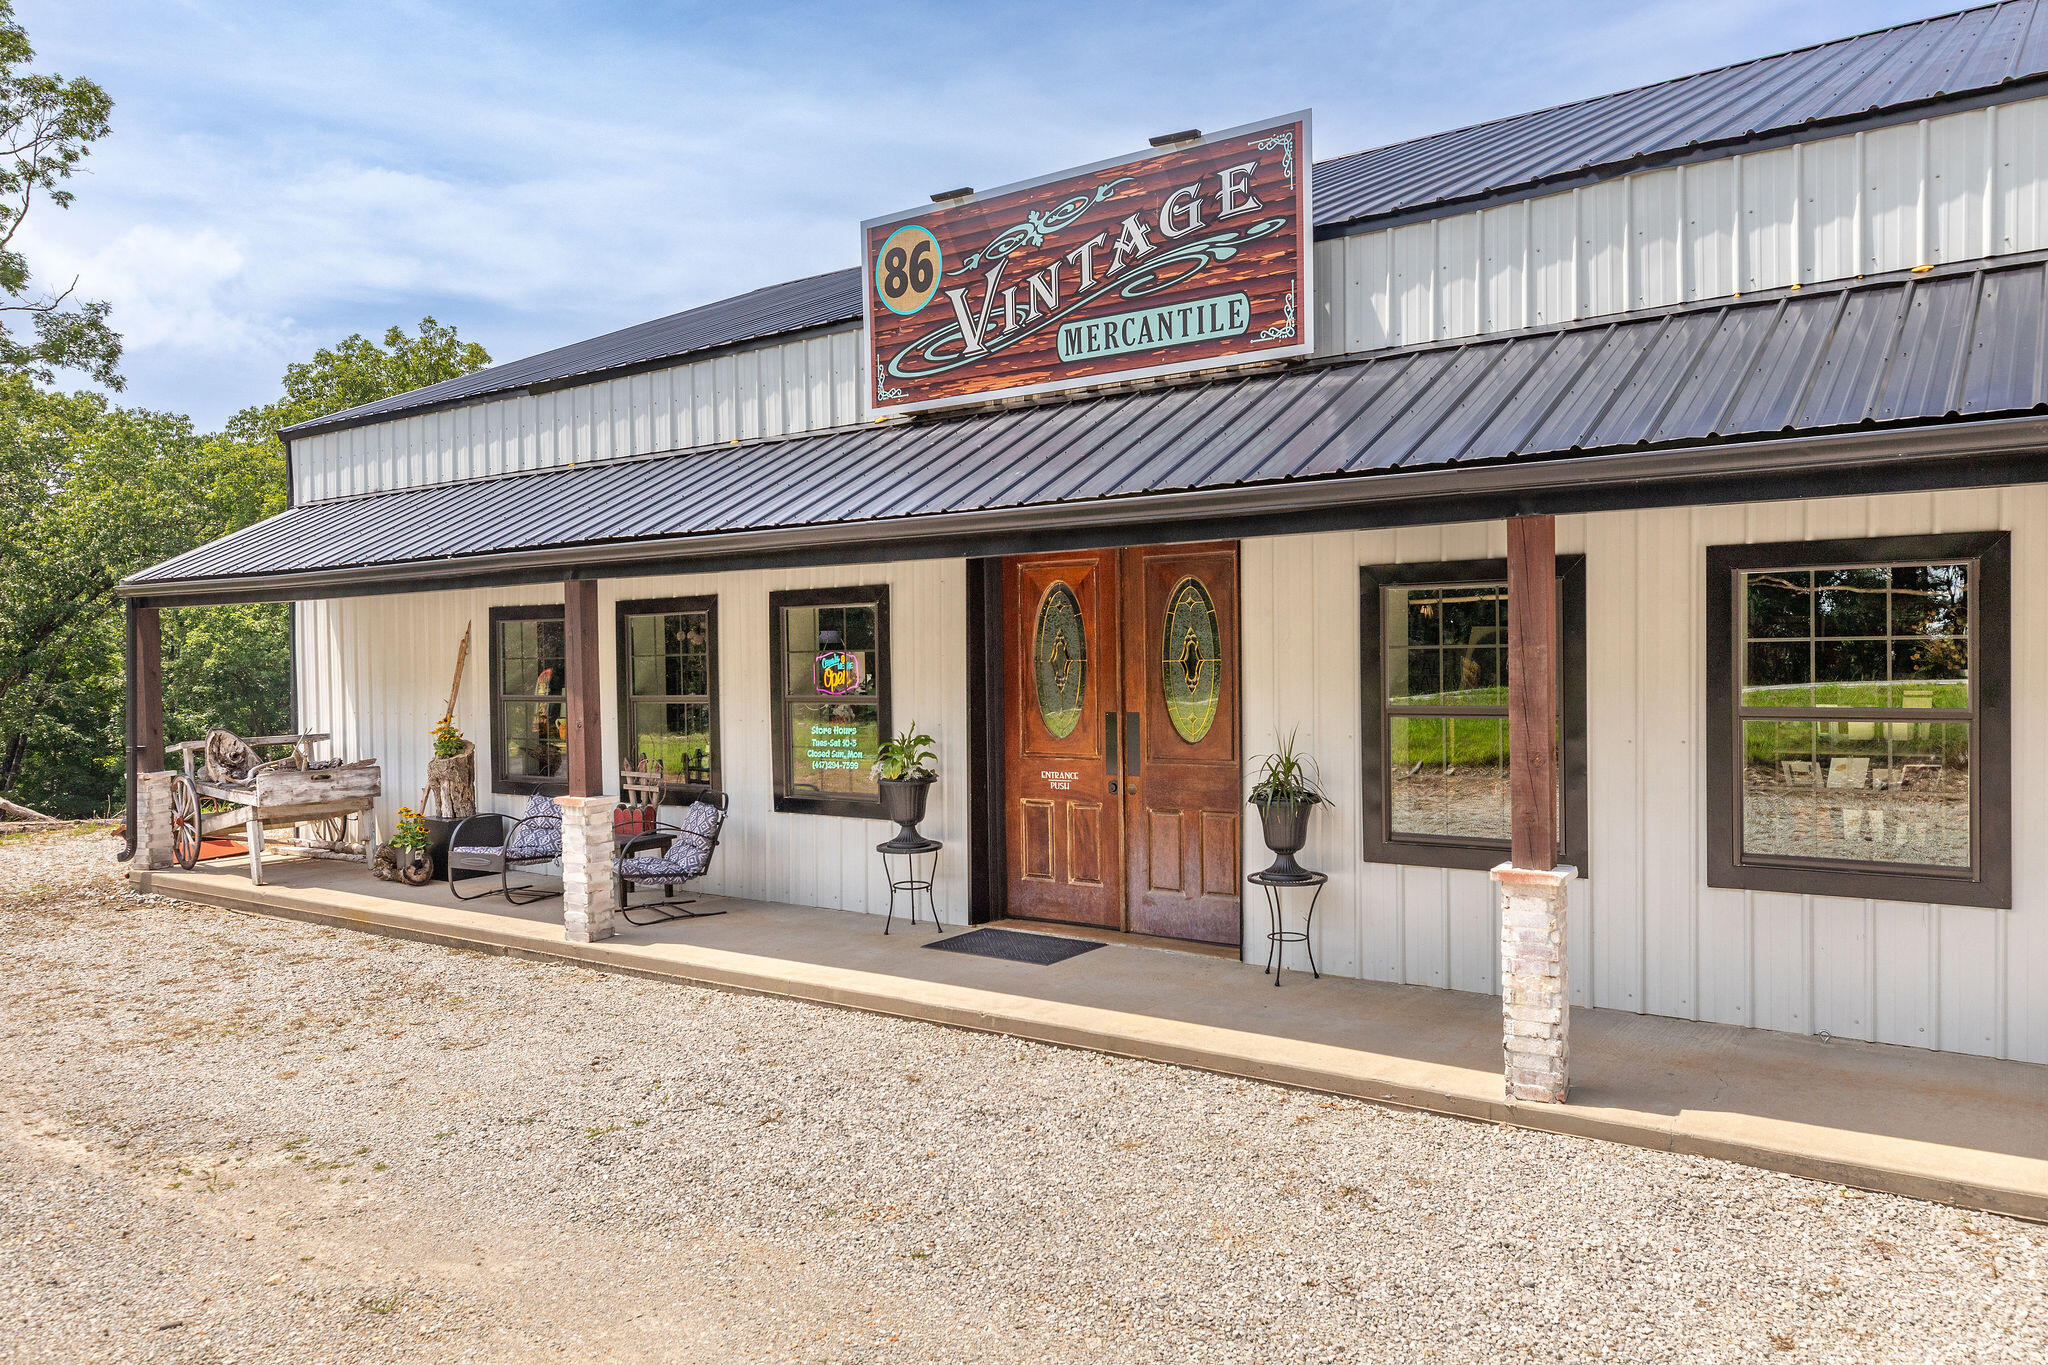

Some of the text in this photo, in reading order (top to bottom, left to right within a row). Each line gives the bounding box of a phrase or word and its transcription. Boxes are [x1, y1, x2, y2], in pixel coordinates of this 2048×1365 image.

[884, 240, 934, 298] 86
[944, 160, 1264, 359] VINTAGE
[1064, 298, 1245, 357] MERCANTILE
[811, 725, 857, 735] Store Hours
[807, 749, 831, 758] Closed
[1041, 771, 1079, 779] ENTRANCE
